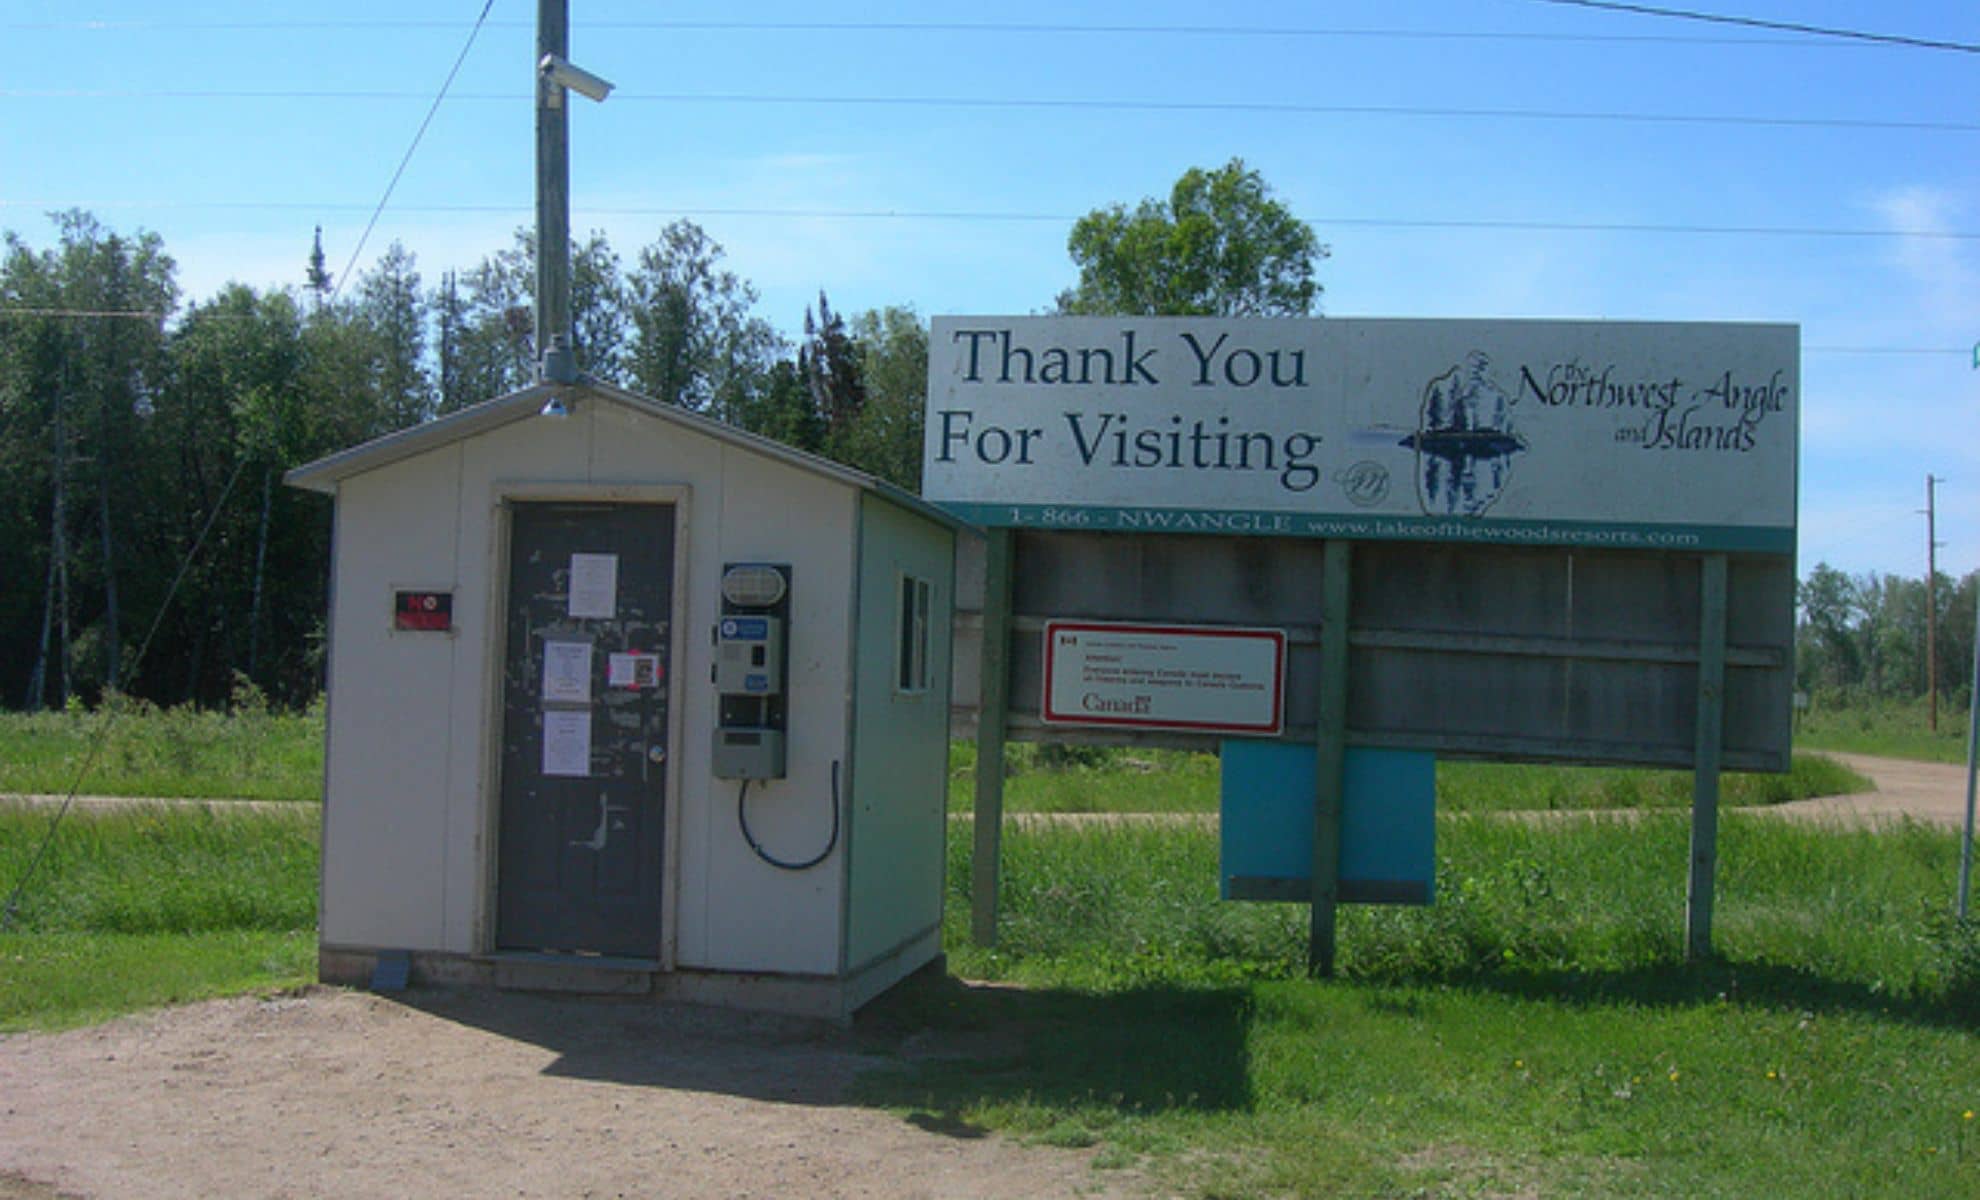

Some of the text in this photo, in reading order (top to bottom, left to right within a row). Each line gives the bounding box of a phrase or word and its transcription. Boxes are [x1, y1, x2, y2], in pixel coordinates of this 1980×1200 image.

[954, 330, 1310, 388] Thank You
[1509, 364, 1683, 408] Northwest
[934, 411, 1043, 465] For
[1064, 413, 1322, 492] Visiting
[1642, 404, 1757, 452] Islands
[1307, 520, 1699, 545] www.lakeofthewoodsresorts.com
